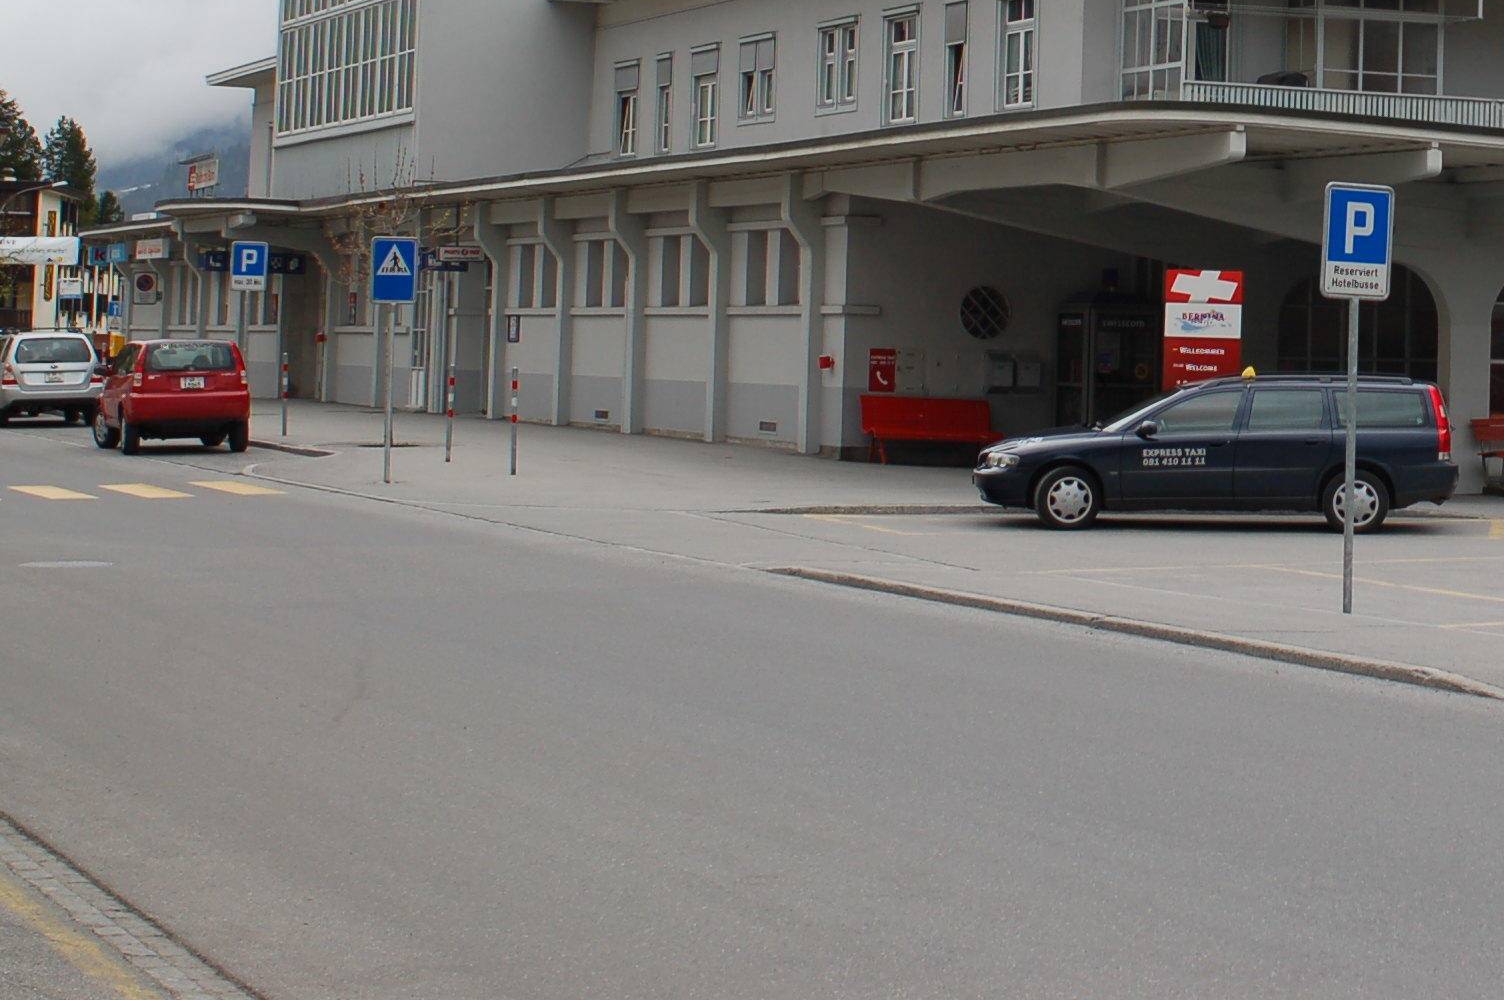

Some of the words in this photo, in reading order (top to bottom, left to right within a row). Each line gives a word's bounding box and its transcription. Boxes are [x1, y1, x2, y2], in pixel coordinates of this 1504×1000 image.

[1344, 201, 1374, 254] P
[242, 249, 258, 272] P
[1334, 265, 1378, 278] Reserviert
[1332, 278, 1380, 290] Hotelbusse
[1182, 311, 1225, 322] BERNINA
[1142, 448, 1182, 456] EXPRESS
[1184, 448, 1206, 456] TAXI
[1181, 457, 1192, 466] 11
[1194, 456, 1206, 465] 11
